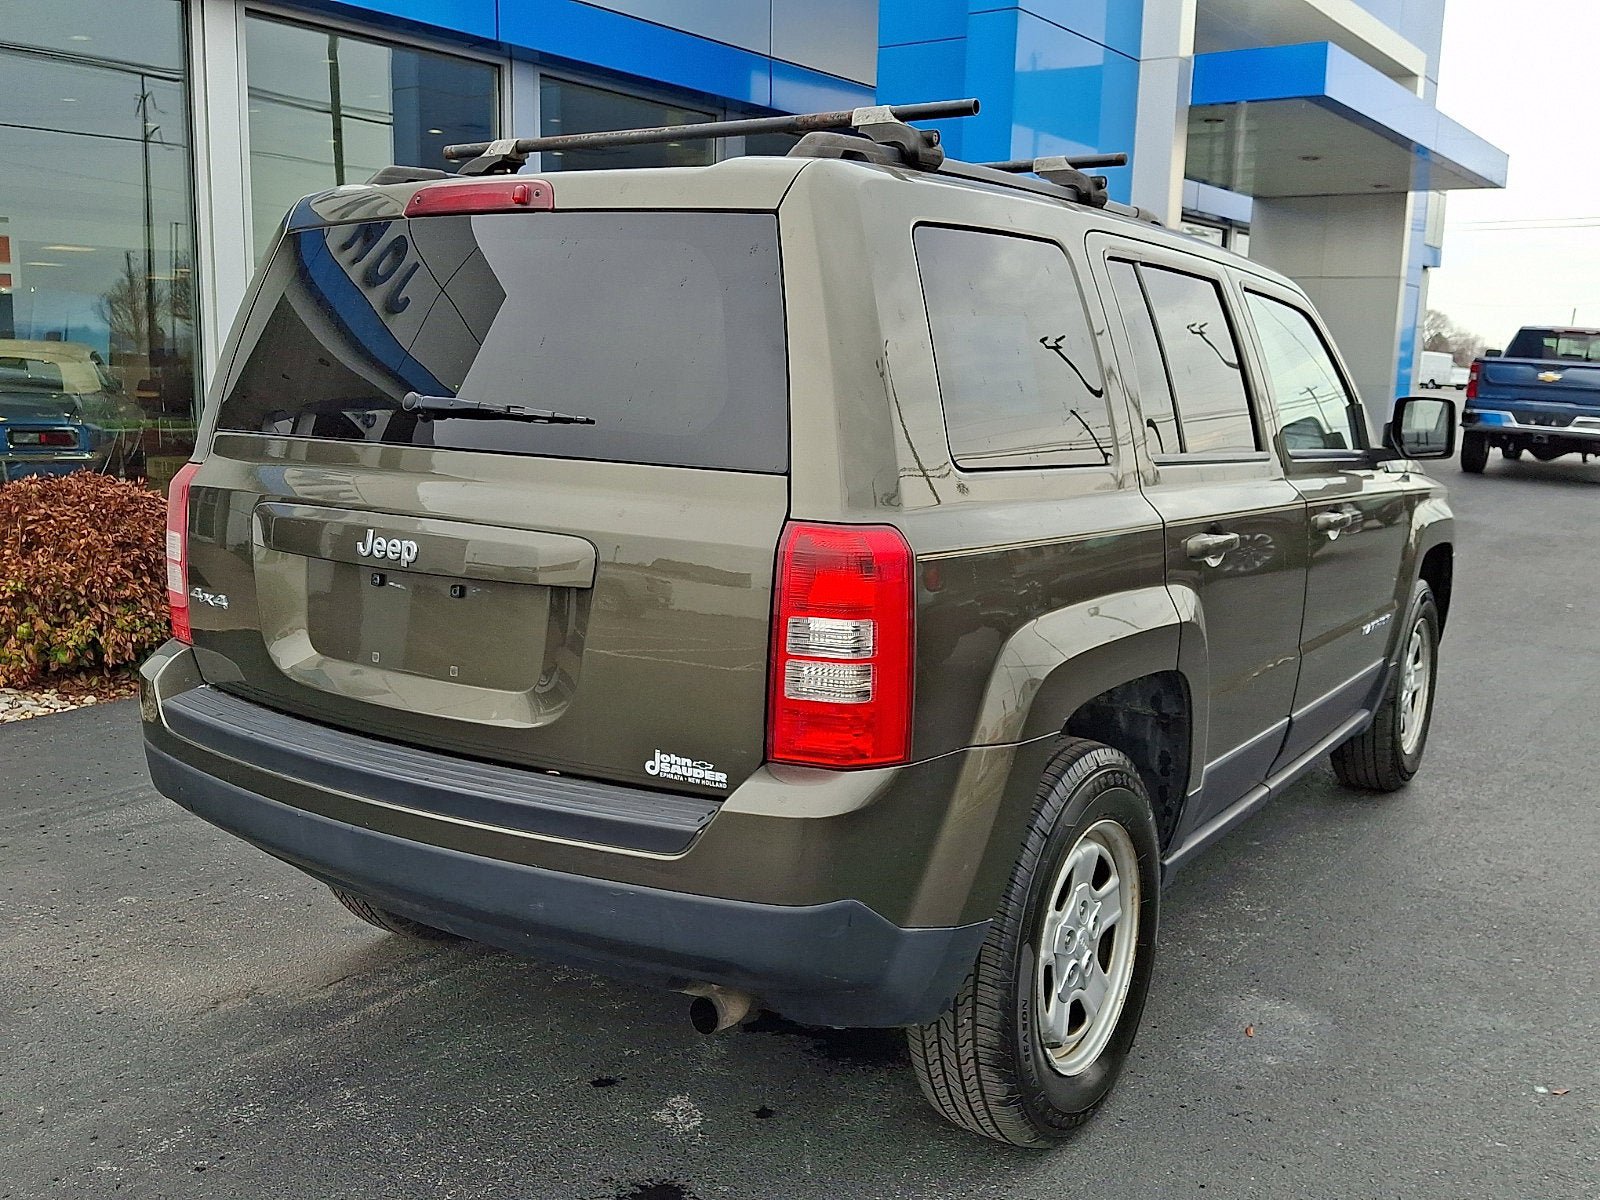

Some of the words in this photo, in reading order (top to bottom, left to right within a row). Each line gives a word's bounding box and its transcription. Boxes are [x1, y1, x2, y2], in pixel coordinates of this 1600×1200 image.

[356, 528, 419, 568] Jeep
[659, 771, 684, 782] EPHRATA
[688, 777, 701, 785] NEW
[701, 779, 728, 789] HOLLAND
[660, 762, 728, 782] SAUDER
[1021, 999, 1032, 1063] SEASON
